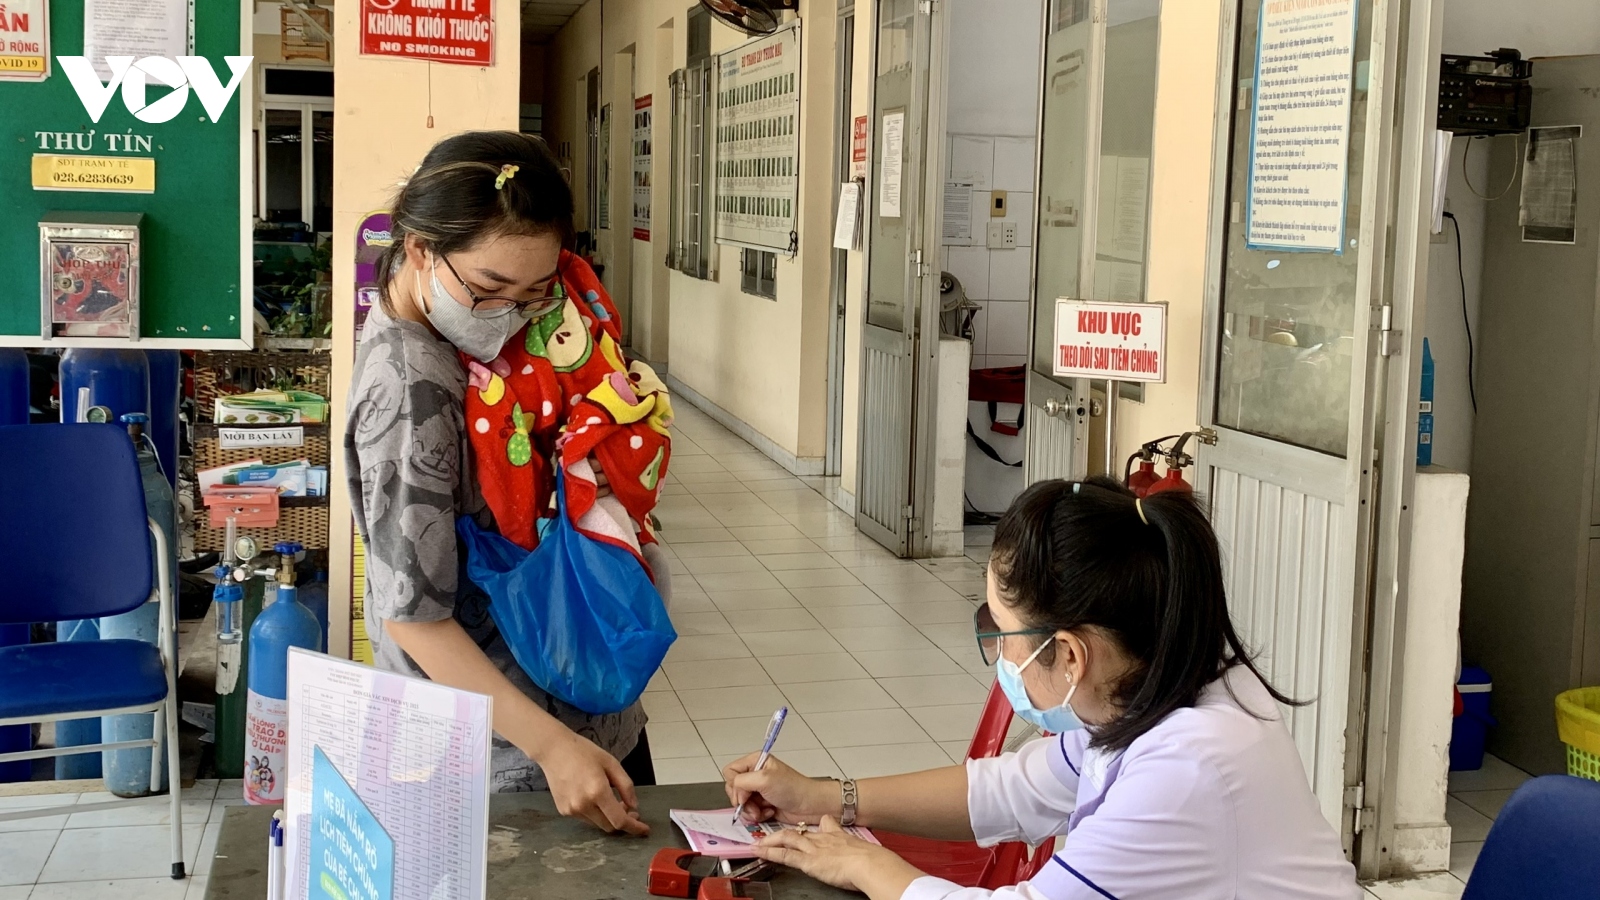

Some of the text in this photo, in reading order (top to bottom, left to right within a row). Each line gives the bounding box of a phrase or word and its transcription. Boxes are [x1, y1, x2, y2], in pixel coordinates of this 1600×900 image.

[368, 10, 489, 42] KHÔNG KHÓI THUỐC
[10, 40, 39, 53] RỘNG
[380, 42, 476, 57] NO SMOKING
[0, 59, 38, 68] VID 19
[35, 128, 153, 152] THƯ TÍN
[53, 172, 134, 184] 028.62836639
[1078, 310, 1142, 341] KHU VỰC
[1060, 341, 1158, 373] THEO DÕI SAU TIÊM CHỦNG
[248, 433, 270, 442] BẠN
[253, 723, 274, 736] TRAO
[259, 743, 274, 754] LẠI
[324, 788, 377, 870] MẸ ĐÃ NẮM RÕ
[320, 815, 335, 842] LỊCH
[336, 828, 353, 863] TIÊM
[324, 846, 338, 877] CỦA
[338, 863, 348, 888] BÉ
